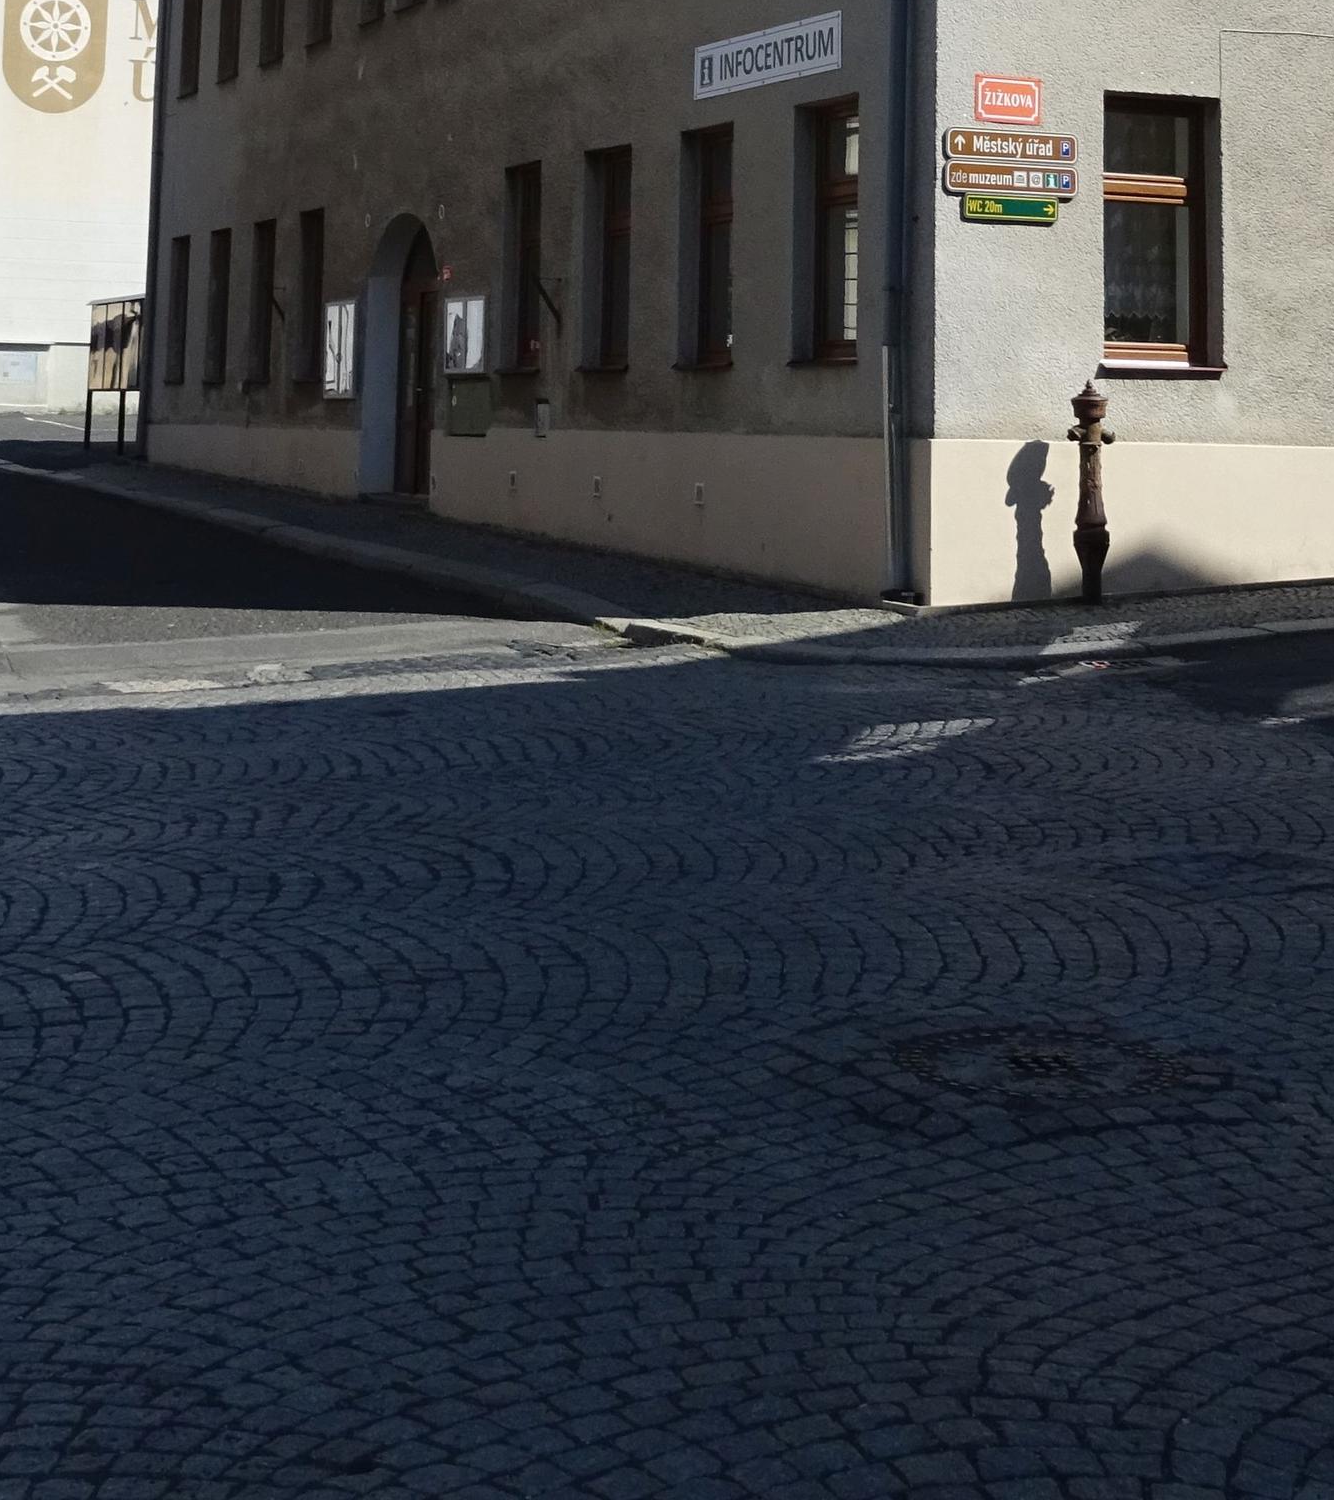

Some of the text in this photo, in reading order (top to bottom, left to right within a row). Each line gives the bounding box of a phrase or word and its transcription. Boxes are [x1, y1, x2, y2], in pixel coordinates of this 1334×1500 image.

[719, 27, 834, 81] INFOCENTRUM
[984, 88, 1033, 108] ŽIŽKOVA
[973, 135, 1023, 158] Městský
[1026, 138, 1053, 156] úřad
[951, 169, 968, 183] zde
[969, 173, 1013, 186] muzeum
[969, 199, 1003, 213] WC 20m
